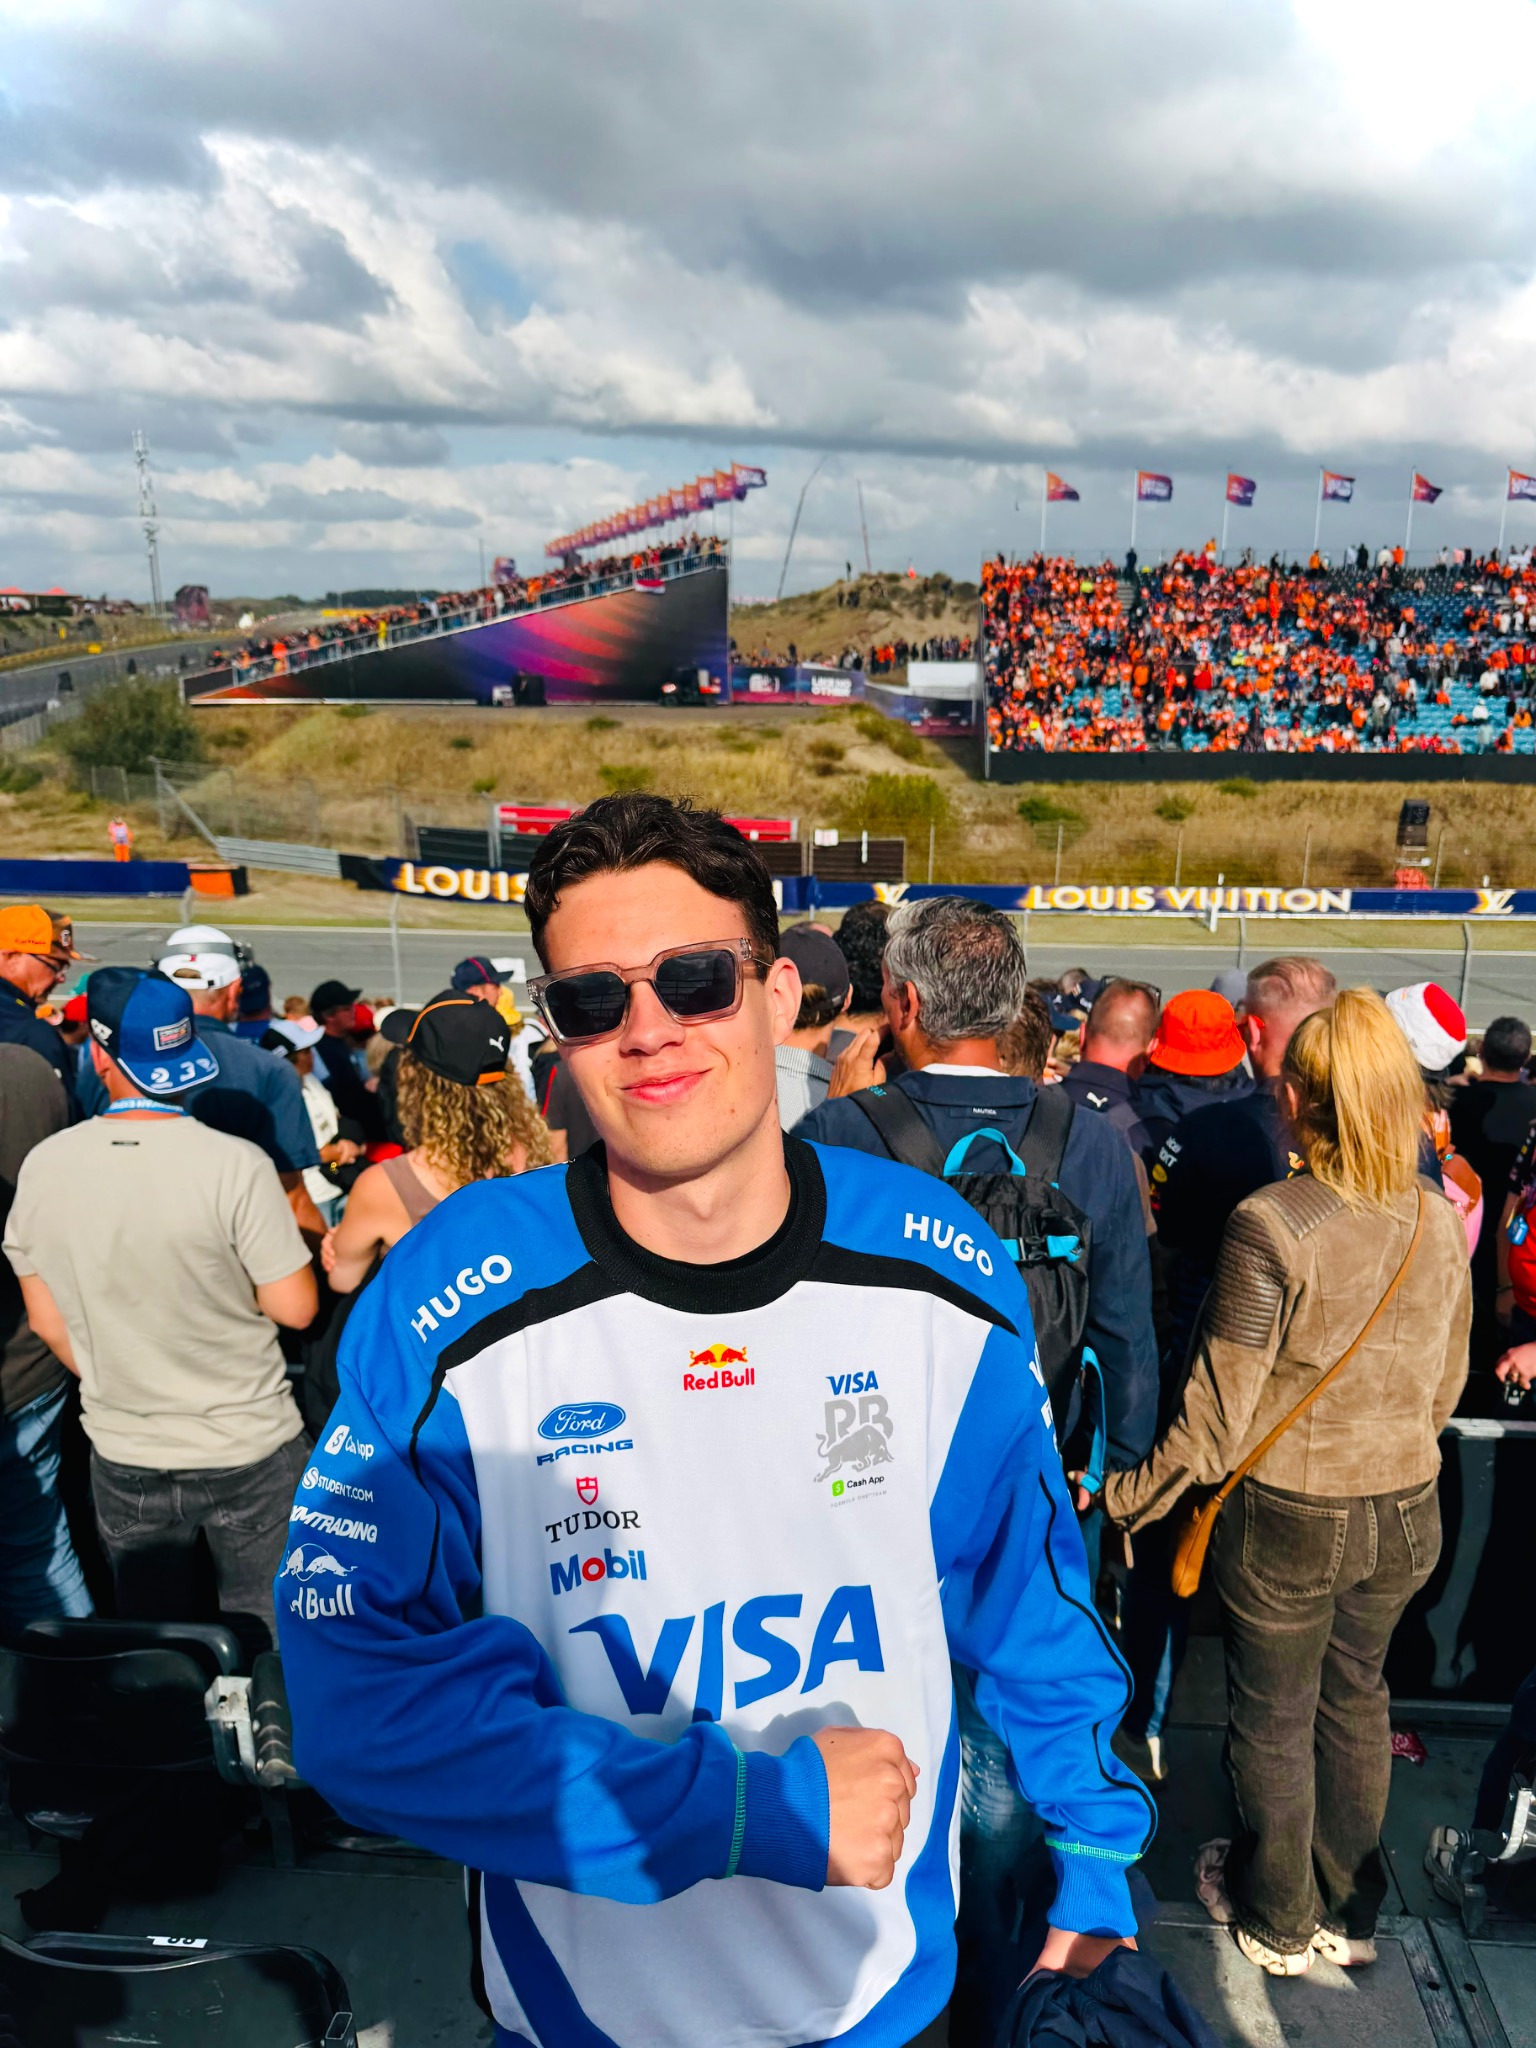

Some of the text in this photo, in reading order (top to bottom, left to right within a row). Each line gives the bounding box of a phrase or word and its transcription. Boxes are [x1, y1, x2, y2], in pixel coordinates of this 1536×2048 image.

[1033, 885, 1352, 912] LOUIS VUITTON
[904, 1212, 994, 1277] HUGO
[410, 1254, 512, 1344] HUGO
[684, 1368, 755, 1391] Red Bull
[826, 1370, 879, 1396] VISA
[554, 1408, 607, 1434] Ford
[536, 1439, 634, 1466] RACING
[318, 1474, 374, 1503] STUDENT.COM
[847, 1476, 885, 1488] Cash App
[545, 1510, 642, 1544] TUDOR
[550, 1547, 648, 1596] Mobil
[306, 1583, 356, 1620] Bull
[568, 1584, 885, 1724] VISA
